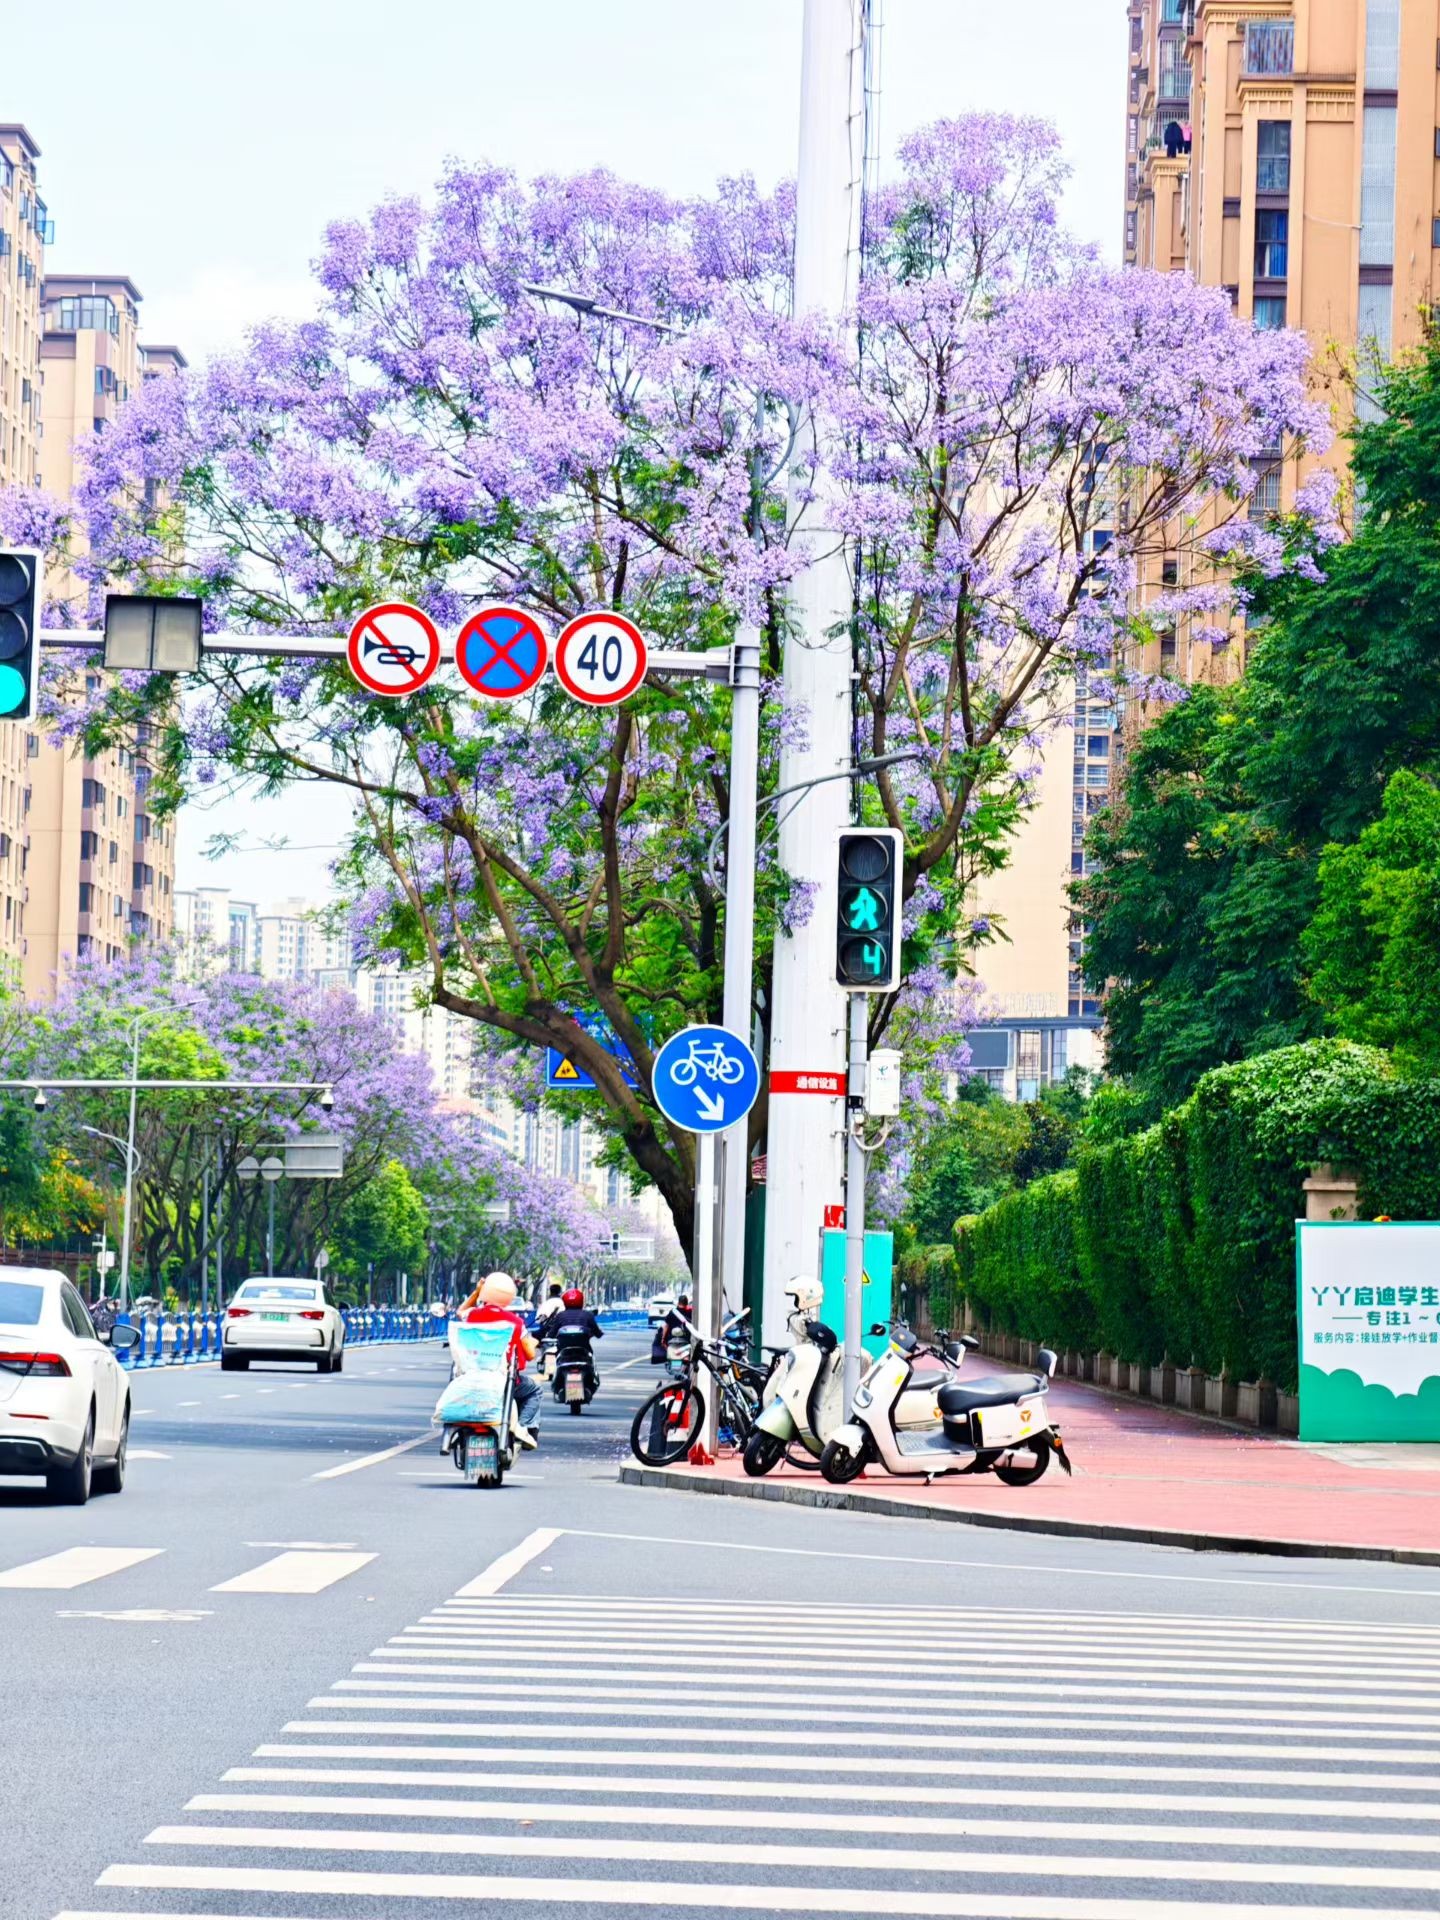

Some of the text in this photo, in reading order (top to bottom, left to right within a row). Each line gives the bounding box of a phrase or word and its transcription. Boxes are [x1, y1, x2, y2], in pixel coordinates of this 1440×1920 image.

[577, 634, 622, 682] 40
[863, 943, 881, 976] 4
[796, 1075, 838, 1090] 通信设施
[1311, 1286, 1439, 1306] YY启迪学生
